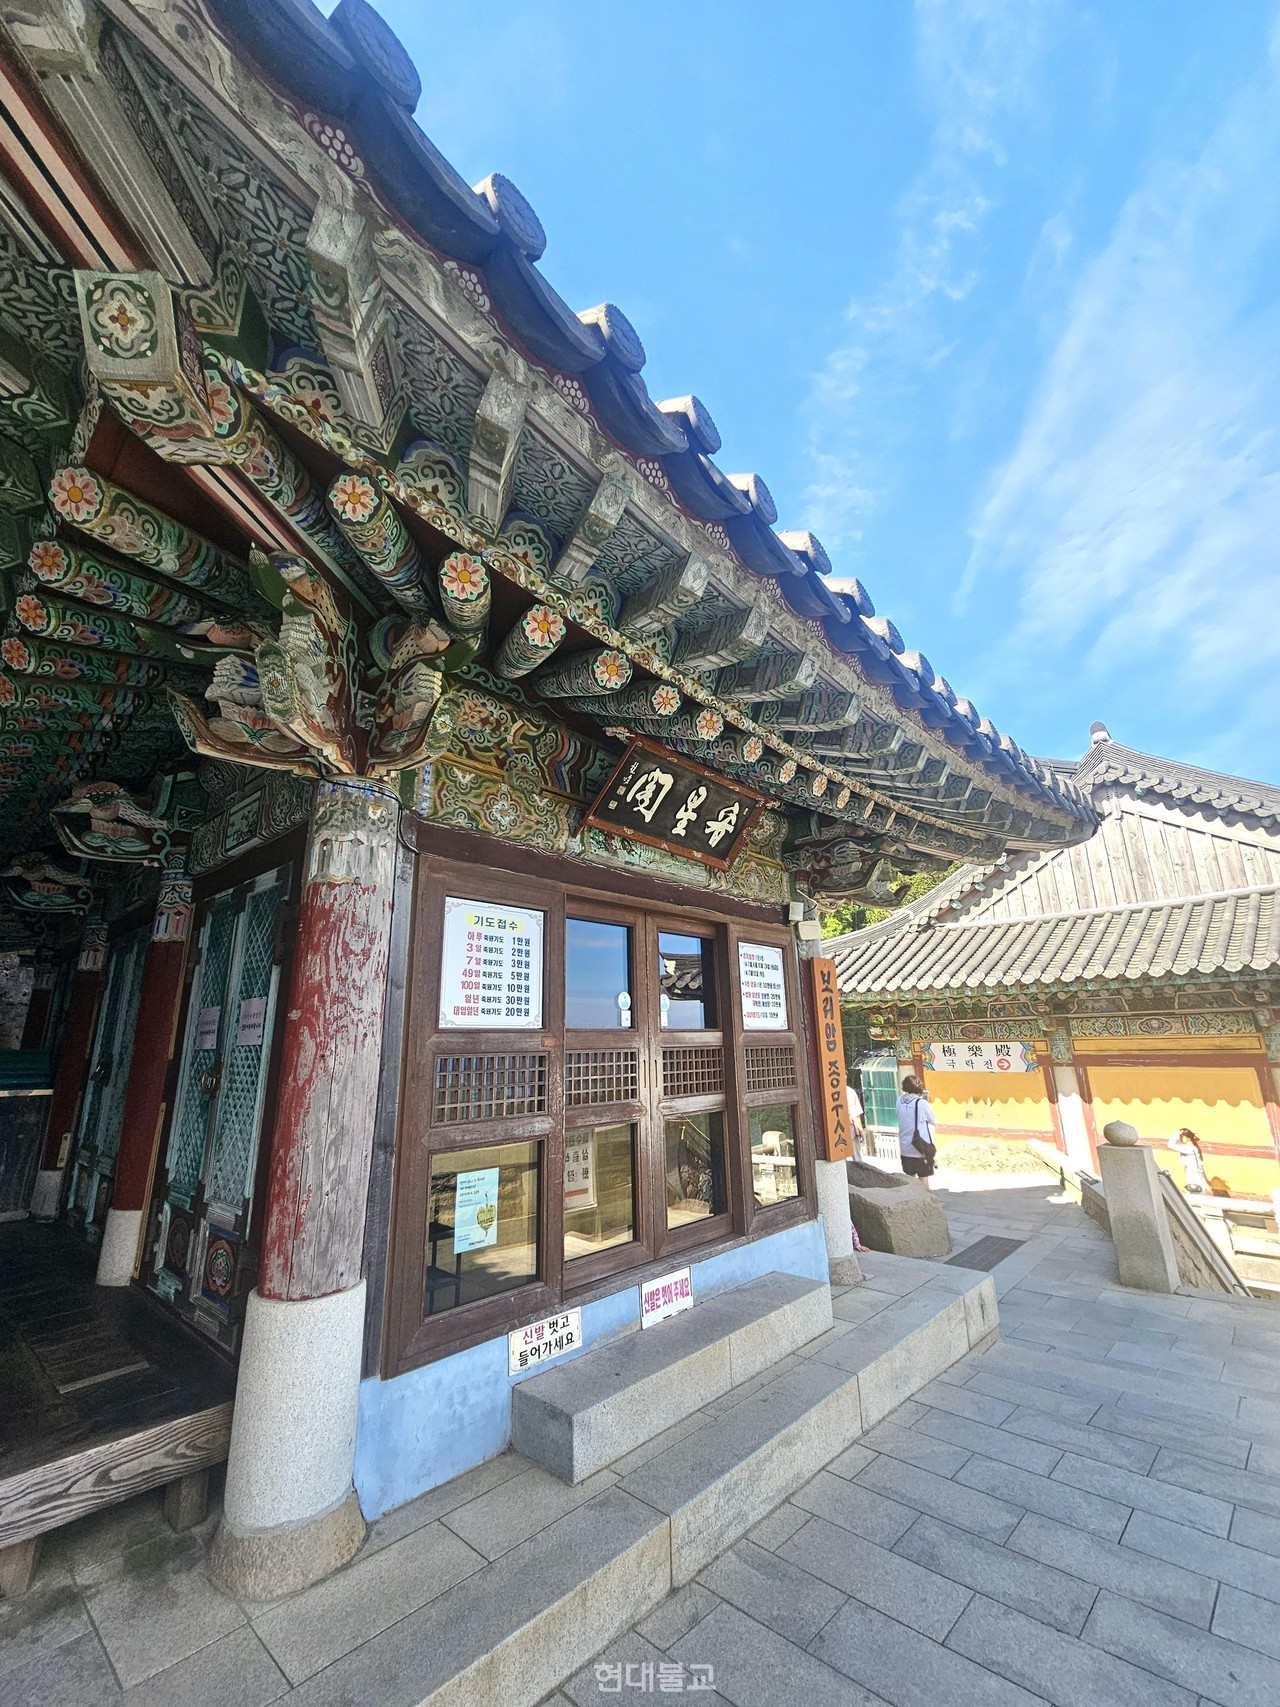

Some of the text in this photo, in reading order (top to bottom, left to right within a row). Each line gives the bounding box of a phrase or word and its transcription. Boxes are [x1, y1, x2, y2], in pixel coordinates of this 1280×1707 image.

[474, 915, 518, 931] 기도접수
[512, 936, 531, 947] 1만원
[511, 947, 530, 958] 2만원
[511, 959, 530, 970] 3만원
[510, 971, 530, 981] 5만원
[507, 983, 530, 994] 10만원
[505, 995, 530, 1006] 30만원
[505, 1007, 530, 1017] 20만원
[942, 1044, 1012, 1058] 極樂殿
[820, 969, 848, 1149] 보리암 종무소
[946, 1058, 994, 1070] 극락전
[643, 1288, 661, 1314] 신발은
[673, 1277, 690, 1302] 주세요
[523, 1315, 570, 1346] 신발 벗고
[518, 1331, 575, 1368] 들어가세요
